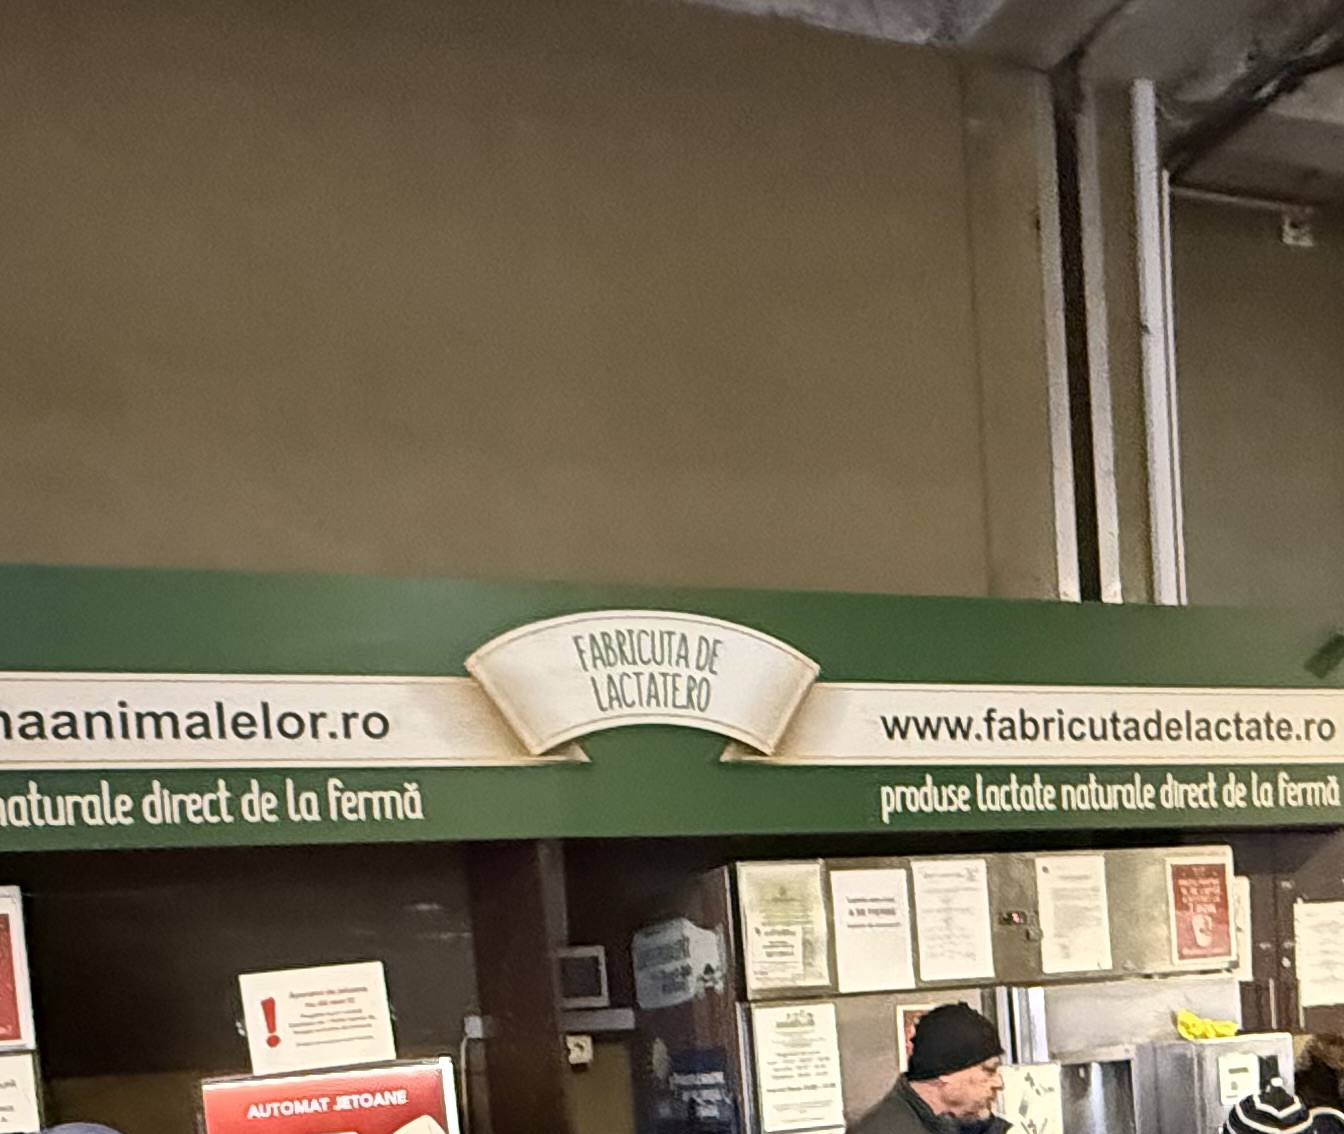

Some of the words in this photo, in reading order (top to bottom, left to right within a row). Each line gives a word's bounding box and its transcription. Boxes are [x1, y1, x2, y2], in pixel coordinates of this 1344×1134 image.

[572, 628, 690, 672] FABRICUTA
[695, 634, 724, 676] DE
[880, 707, 1337, 742] www.fabricutadelactate.ro
[141, 777, 235, 826] direct
[241, 777, 279, 824] de
[285, 776, 322, 822] la
[326, 776, 425, 823] fermă
[881, 772, 972, 825] produse
[975, 772, 1056, 813] lactate
[1061, 772, 1156, 811] naturale
[1159, 771, 1219, 810] direct
[1222, 771, 1248, 809] de
[1251, 770, 1275, 808] la
[1277, 770, 1342, 808] fermă
[246, 1097, 331, 1119] AUTOMAT
[332, 1089, 408, 1111] JETOANE
